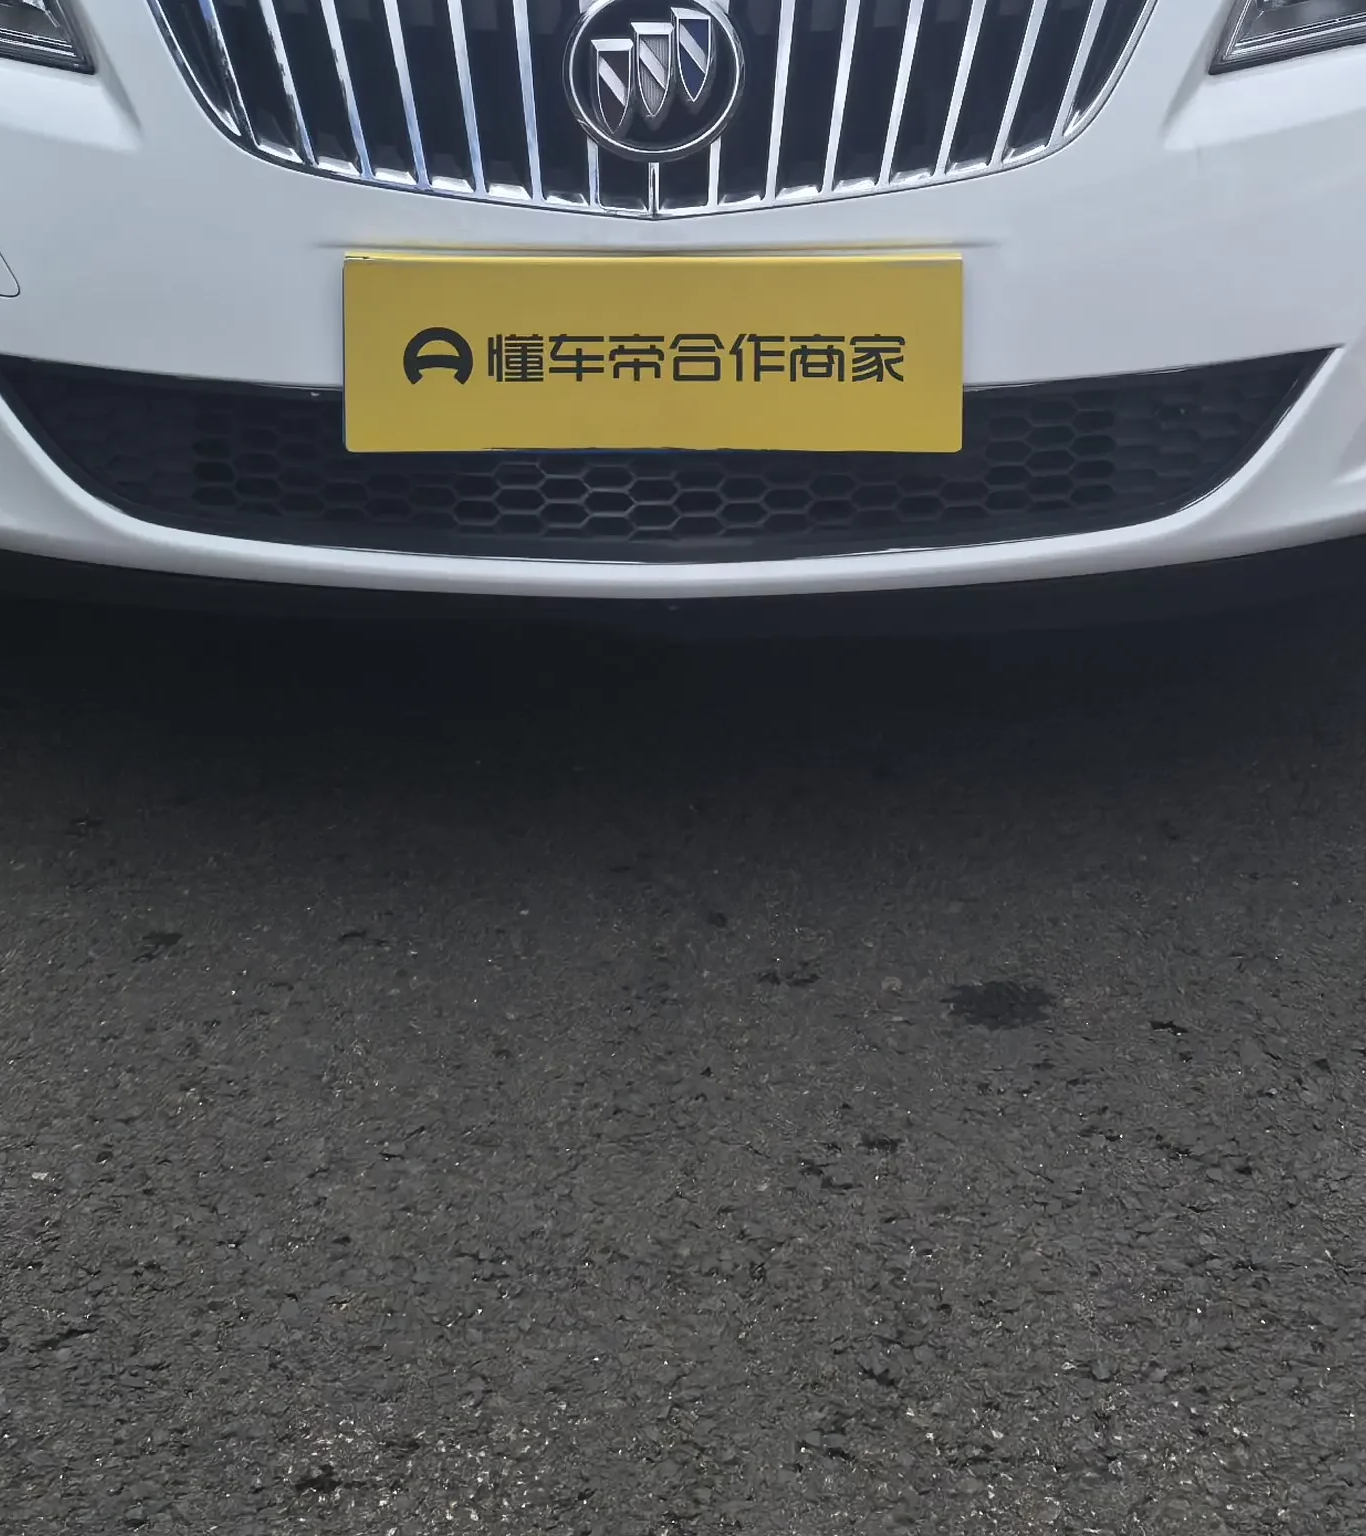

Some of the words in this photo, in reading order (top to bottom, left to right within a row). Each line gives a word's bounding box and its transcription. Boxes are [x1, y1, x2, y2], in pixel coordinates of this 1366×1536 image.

[487, 332, 906, 384] 懂车帝合作商家
